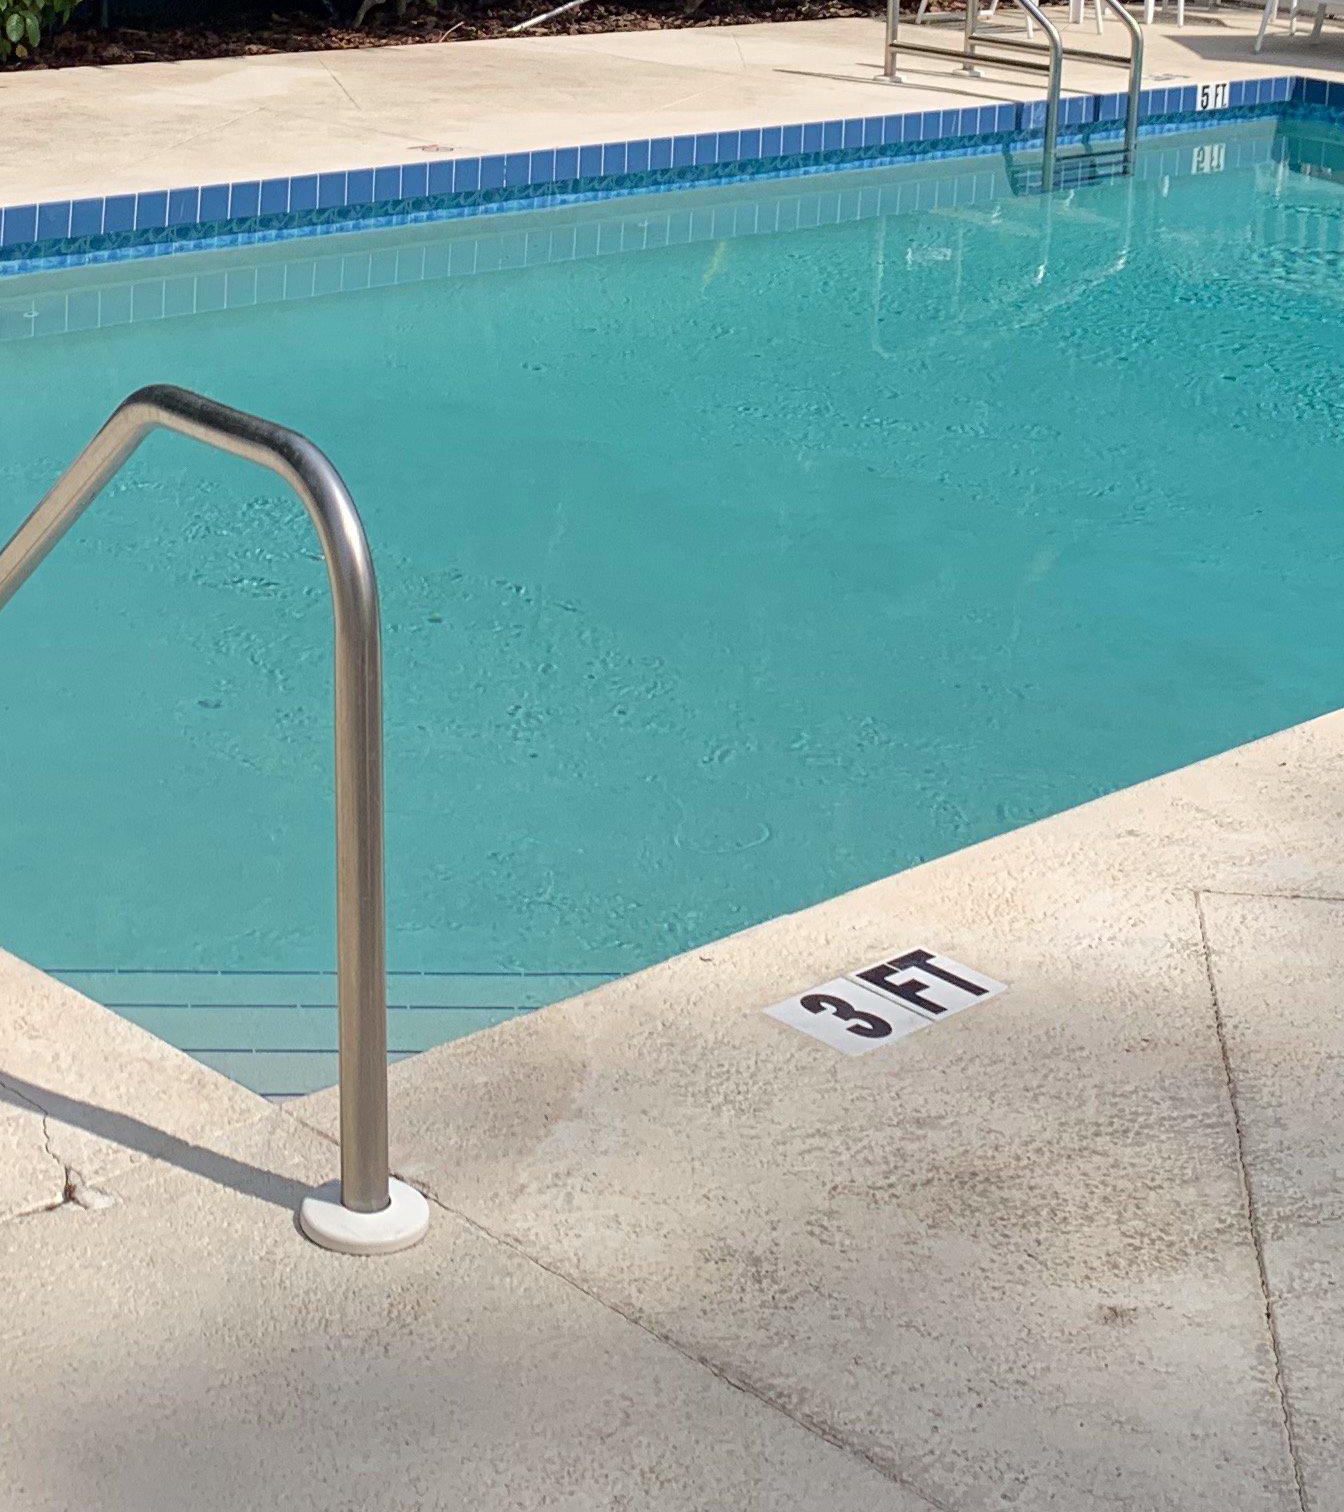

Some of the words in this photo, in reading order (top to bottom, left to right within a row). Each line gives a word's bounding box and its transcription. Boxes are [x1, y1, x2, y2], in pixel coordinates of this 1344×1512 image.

[1200, 85, 1210, 109] 5
[800, 994, 892, 1038] 3
[856, 949, 989, 1014] FT
